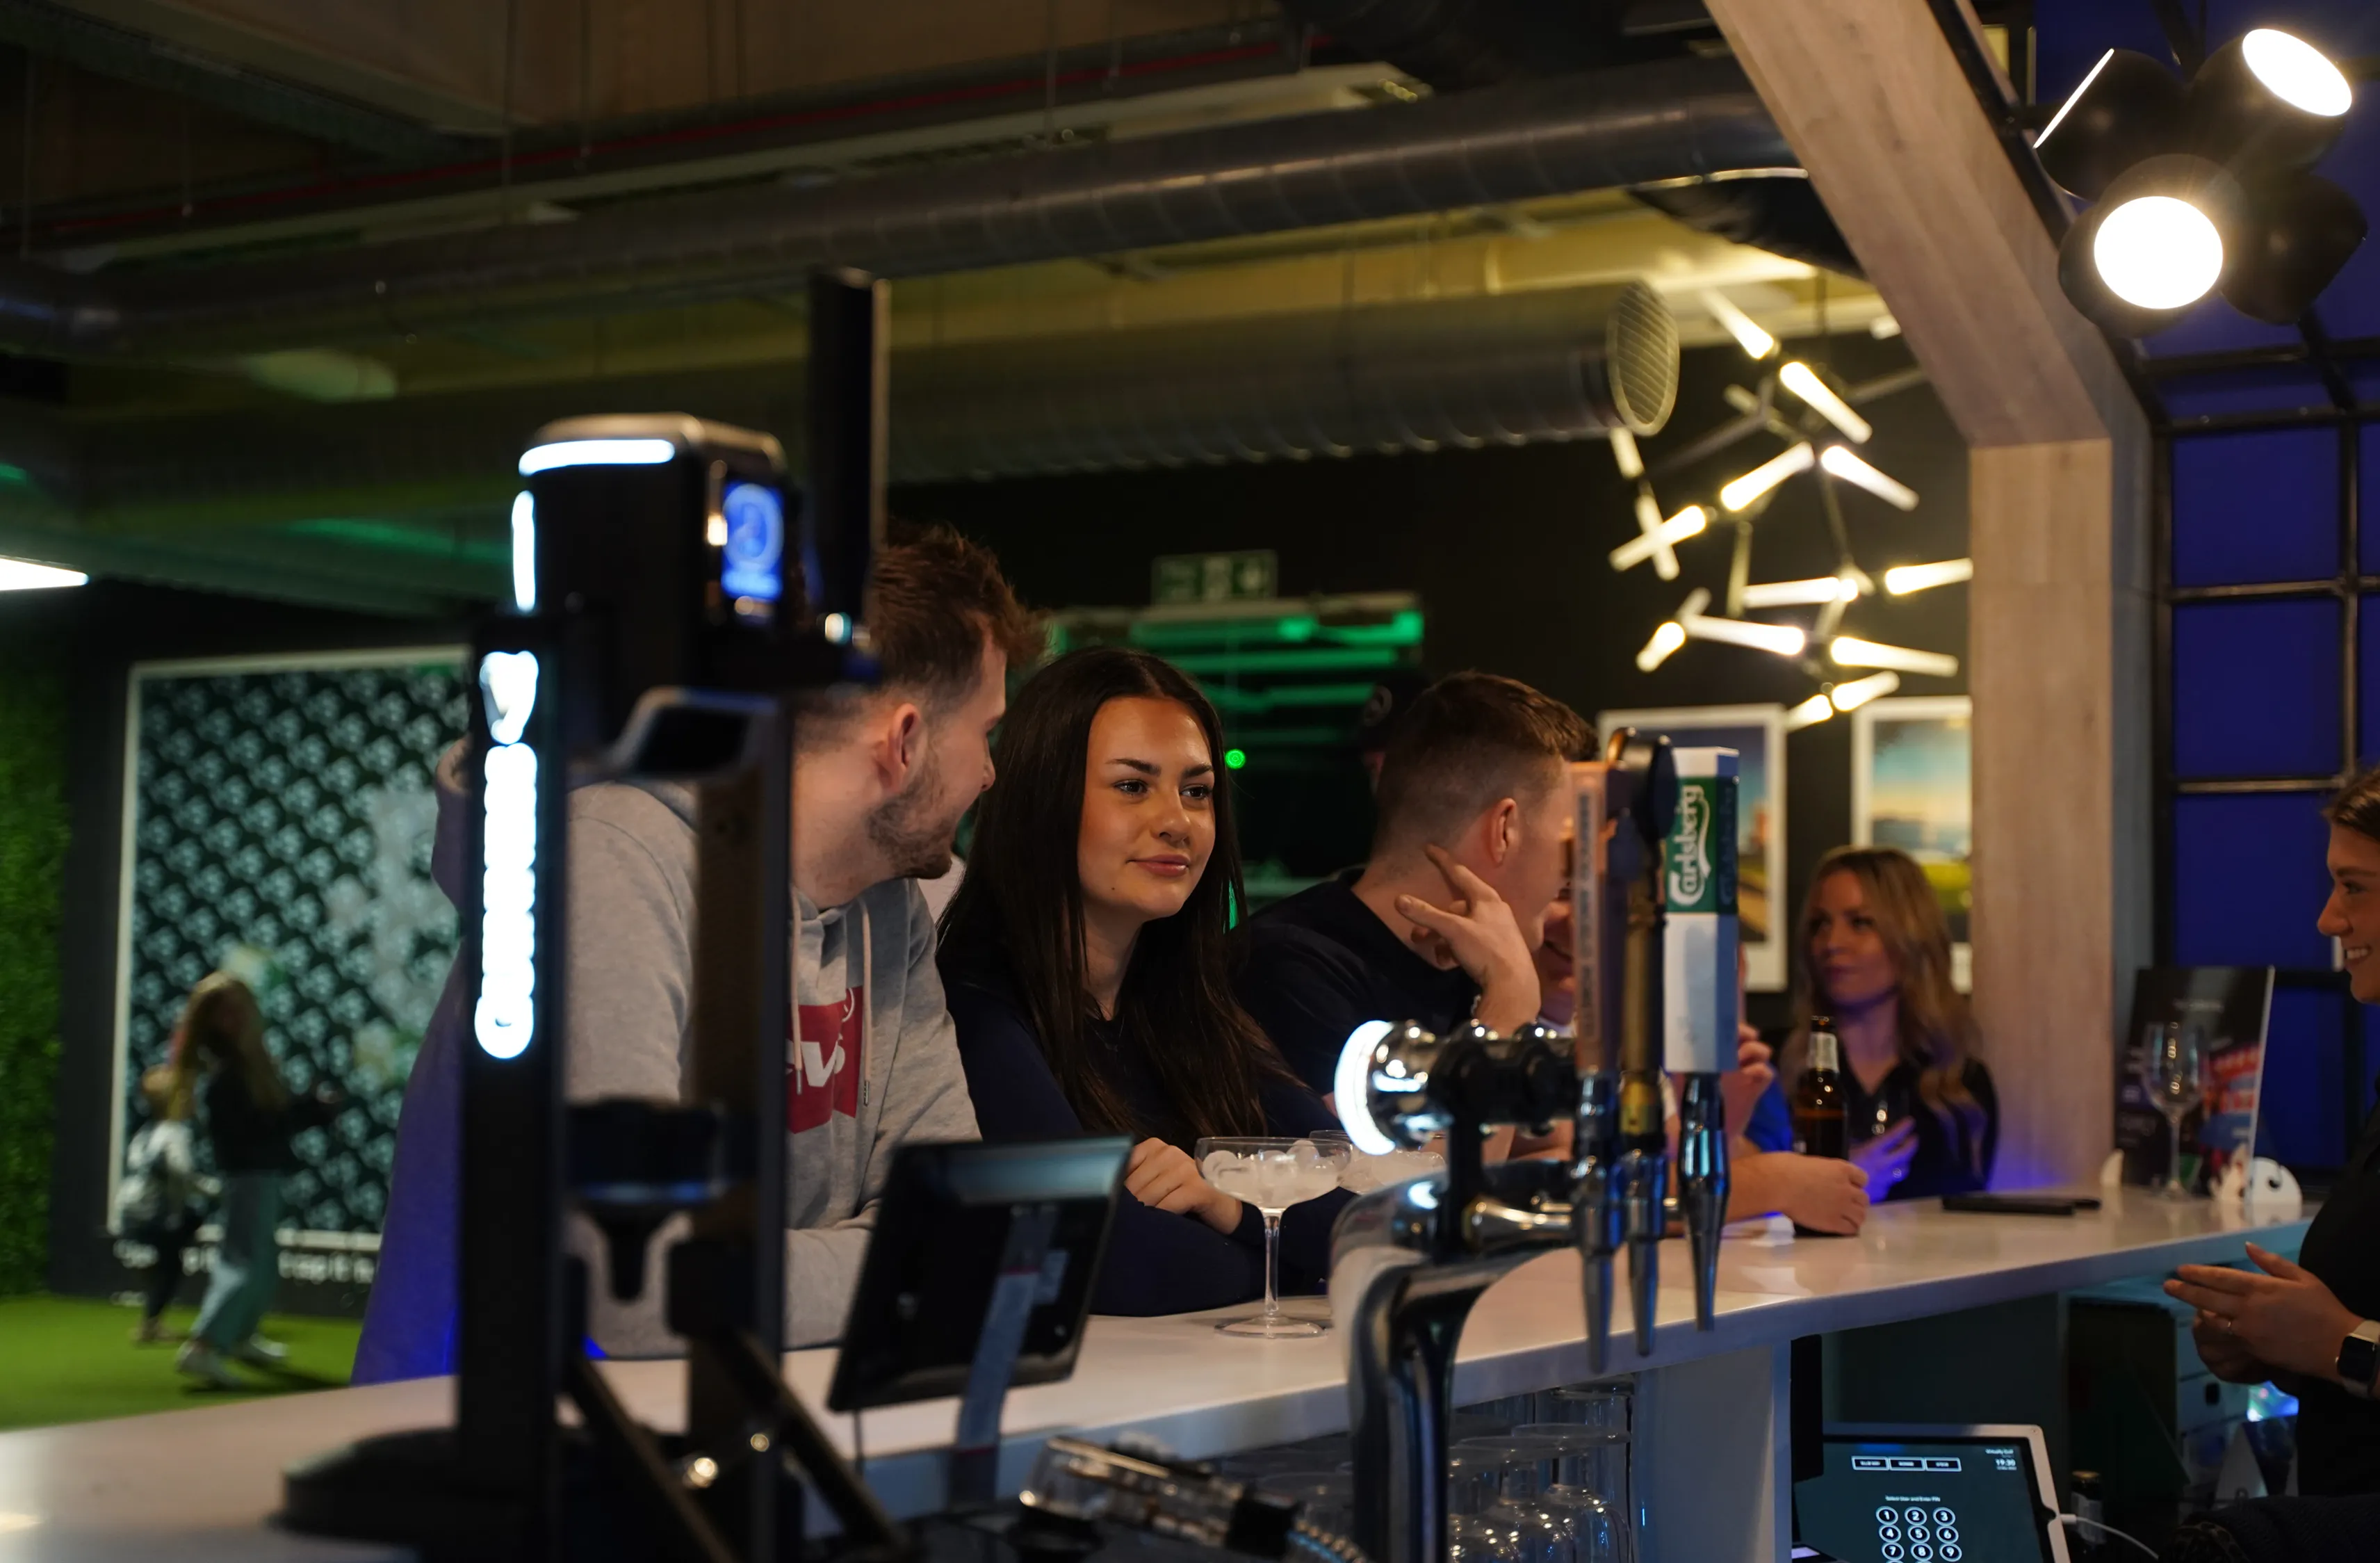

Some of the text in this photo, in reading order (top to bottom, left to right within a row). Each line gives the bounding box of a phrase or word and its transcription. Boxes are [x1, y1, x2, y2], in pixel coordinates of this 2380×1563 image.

[1670, 784, 1711, 907] Carlsberg
[1995, 1458, 2016, 1466] 19:30
[1884, 1510, 1948, 1521] 1 2 3
[1886, 1528, 1952, 1539] 4 5 6
[1889, 1545, 1955, 1557] 7 8 9
